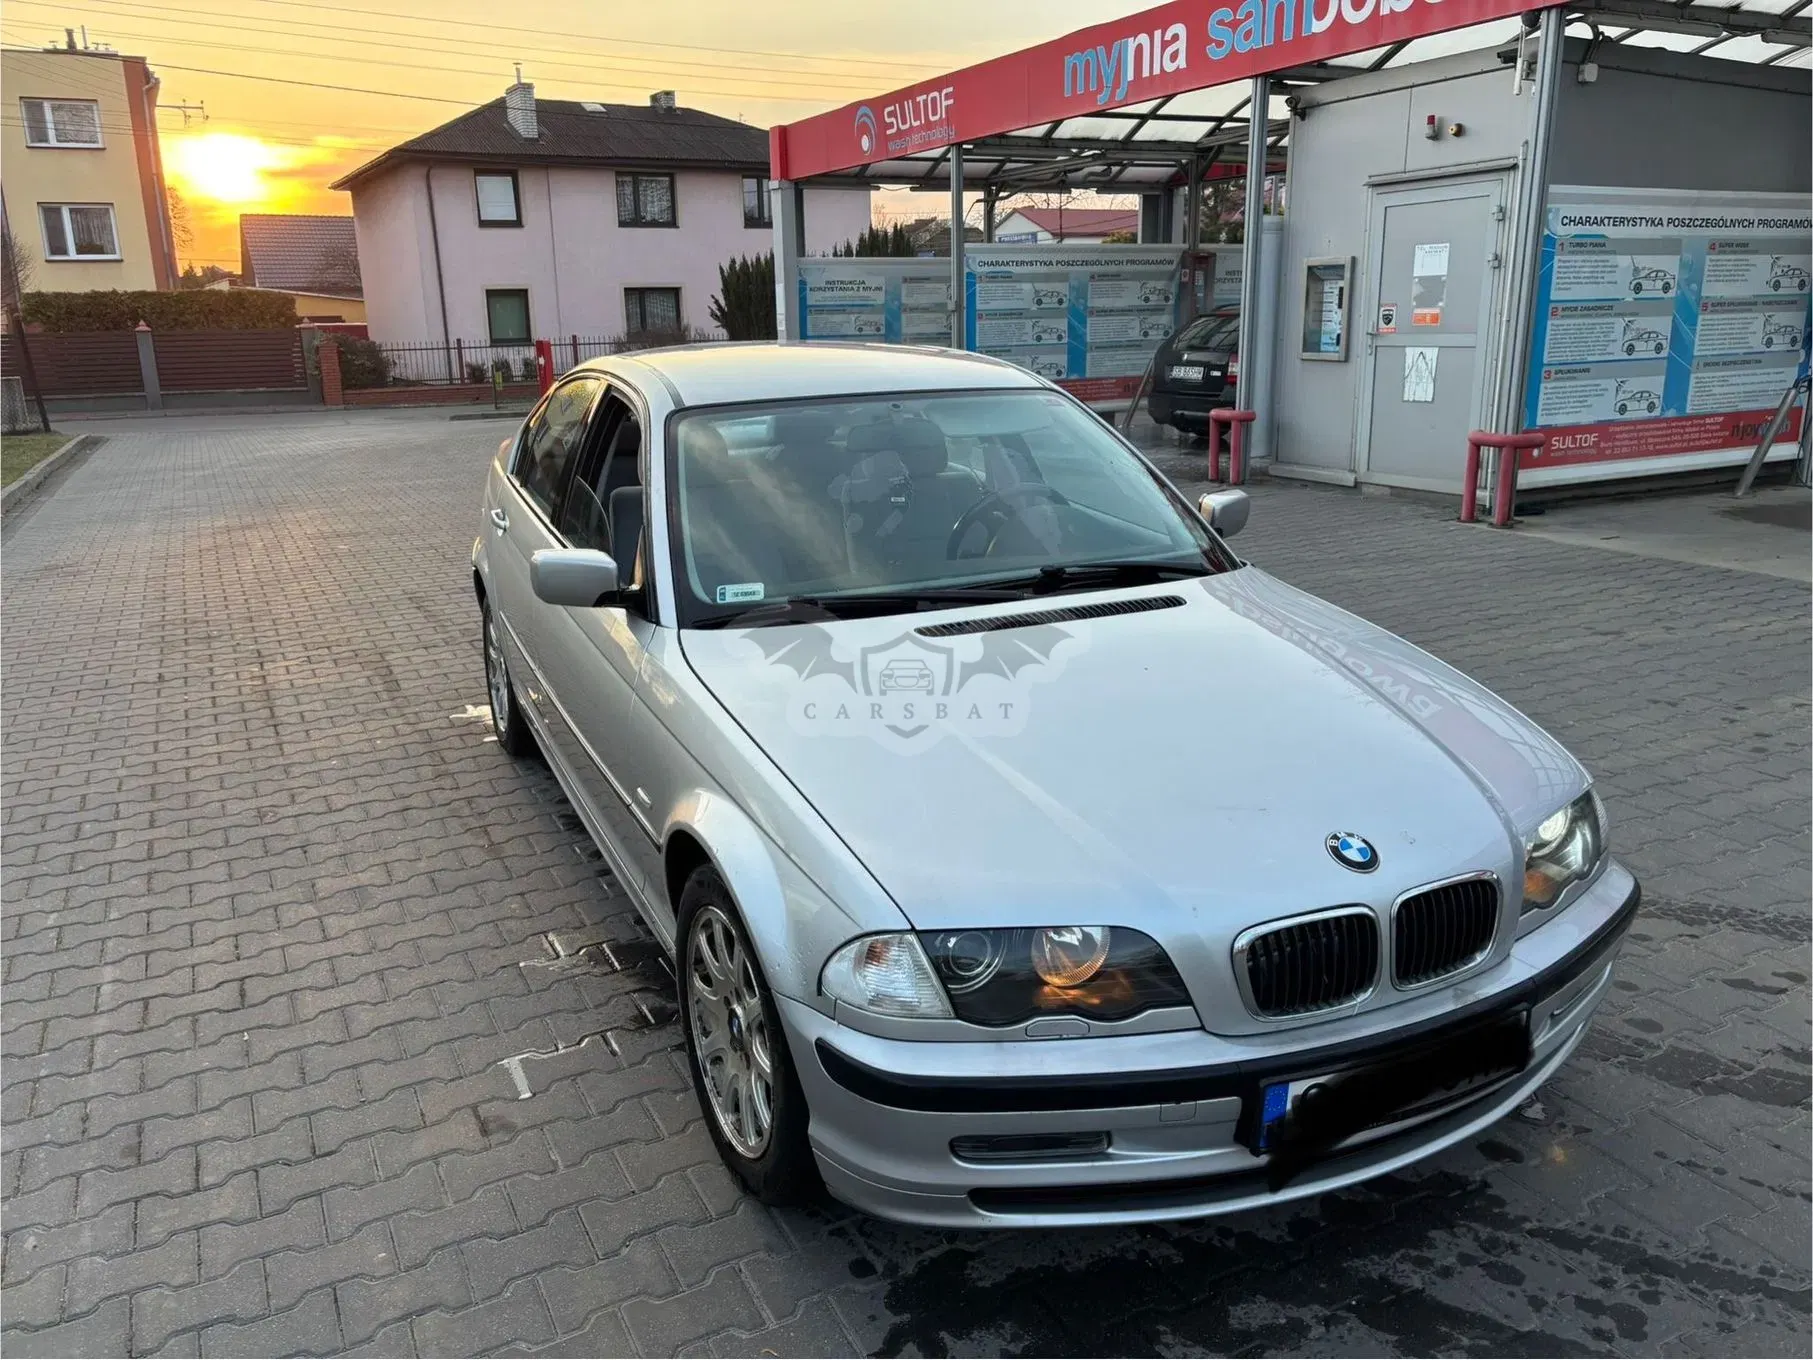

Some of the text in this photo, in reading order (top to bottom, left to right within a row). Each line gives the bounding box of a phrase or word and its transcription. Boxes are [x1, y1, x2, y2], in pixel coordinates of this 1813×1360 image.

[1064, 22, 1188, 105] myjnia
[884, 86, 954, 135] SULTOF
[888, 123, 955, 152] wash technology
[1560, 215, 1665, 228] CHARAKTERYSTYKA
[1667, 215, 1755, 229] POSZCZEGÓLNYCH
[1558, 242, 1564, 252] 1
[977, 258, 1175, 268] CHARAKTERYSTYKA POSZCZEGÓLNYCH PROGRAMÓW
[1551, 306, 1560, 317] 2
[1543, 370, 1552, 379] 3
[1550, 433, 1599, 449] SULTOF
